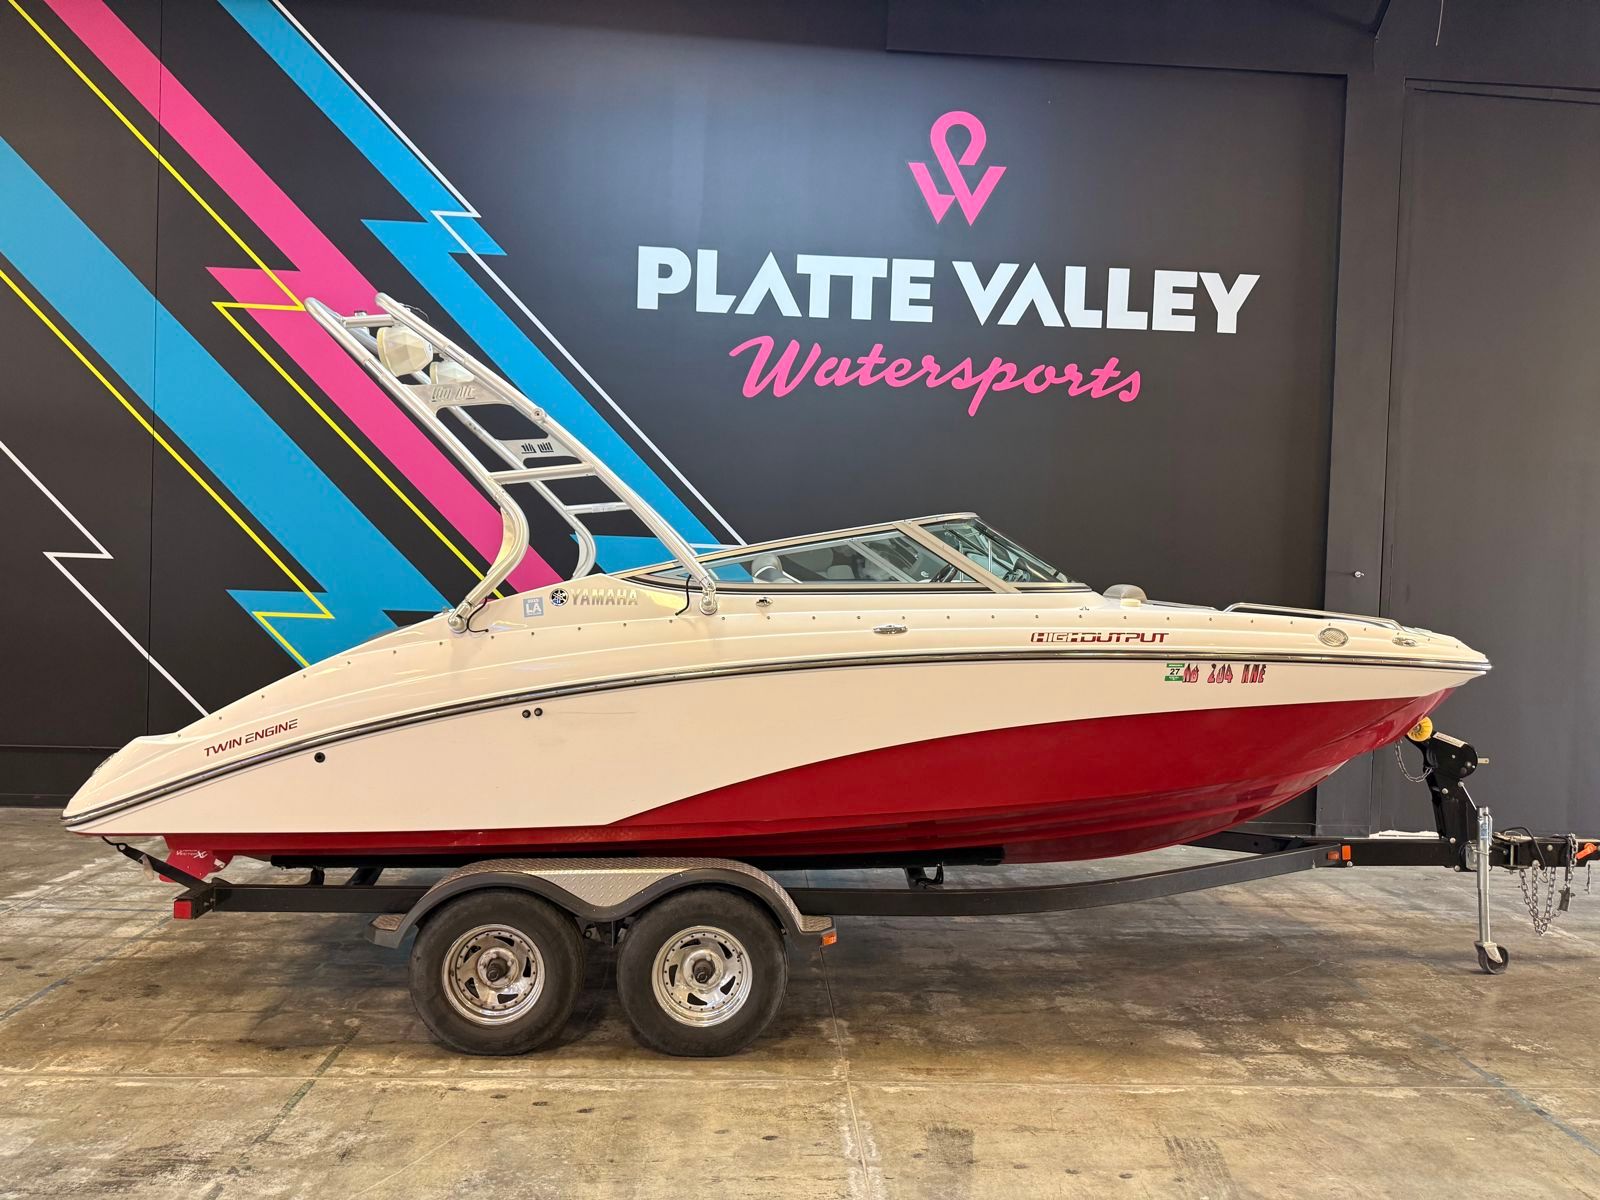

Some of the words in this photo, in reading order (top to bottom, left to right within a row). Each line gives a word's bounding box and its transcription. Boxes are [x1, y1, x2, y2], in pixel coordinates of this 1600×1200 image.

[636, 245, 935, 323] PLATTE
[951, 260, 1260, 335] VALLEY
[728, 335, 1141, 417] Watersports
[570, 588, 638, 606] YAMAHA
[1169, 668, 1181, 676] 27
[204, 736, 242, 757] TWIN
[245, 718, 298, 744] ENGINE
